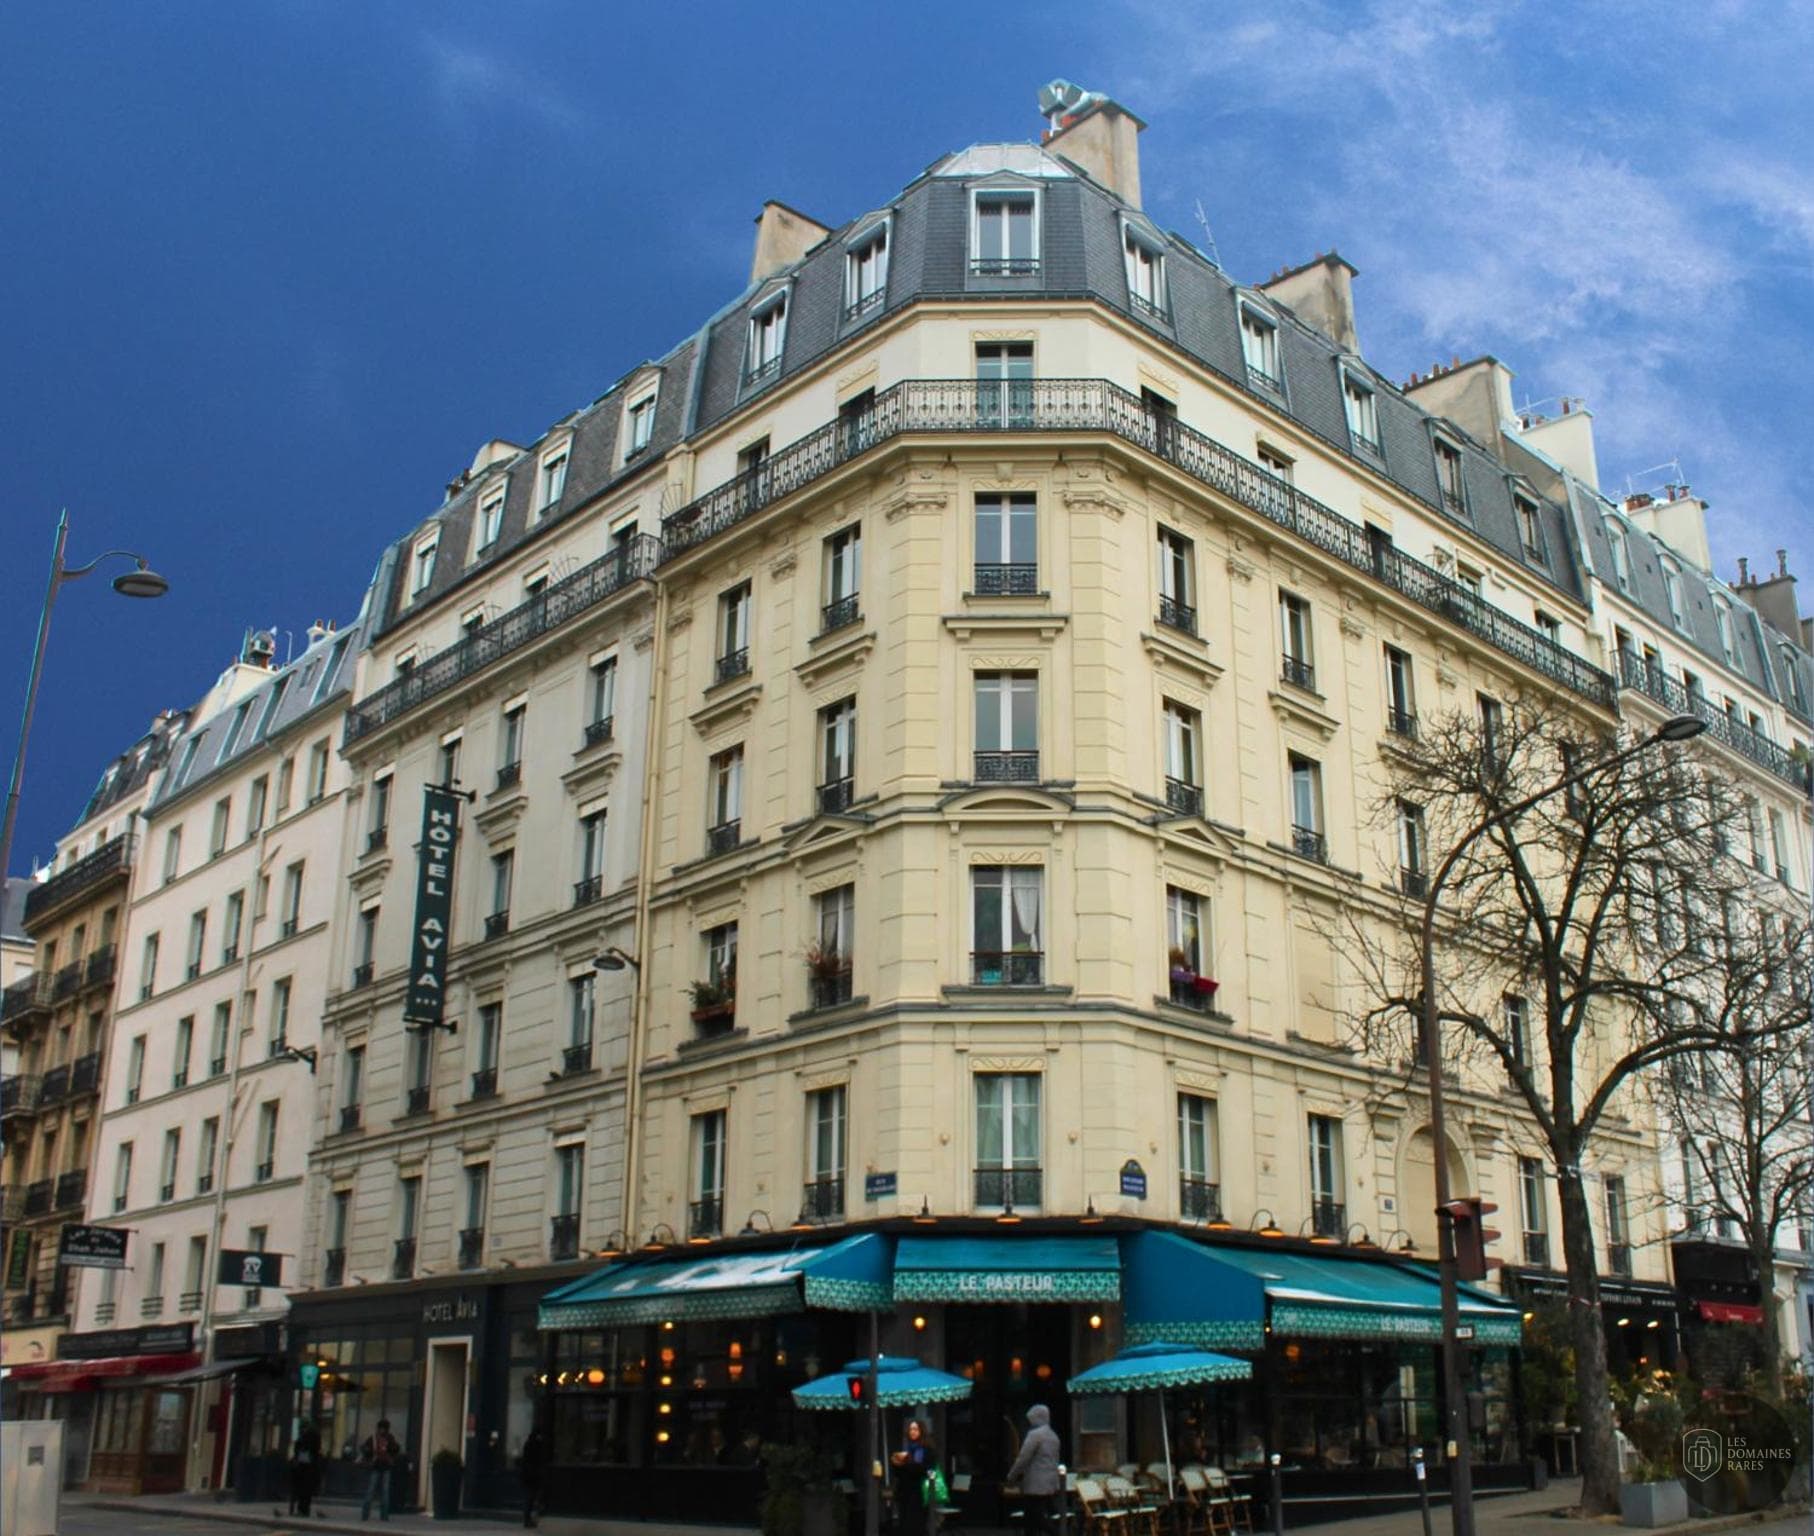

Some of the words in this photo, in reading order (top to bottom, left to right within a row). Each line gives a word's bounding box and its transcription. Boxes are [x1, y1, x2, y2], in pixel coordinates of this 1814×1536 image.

[416, 918, 444, 988] AVIA
[960, 1276, 977, 1291] LE
[985, 1275, 1053, 1291] PASTEUR
